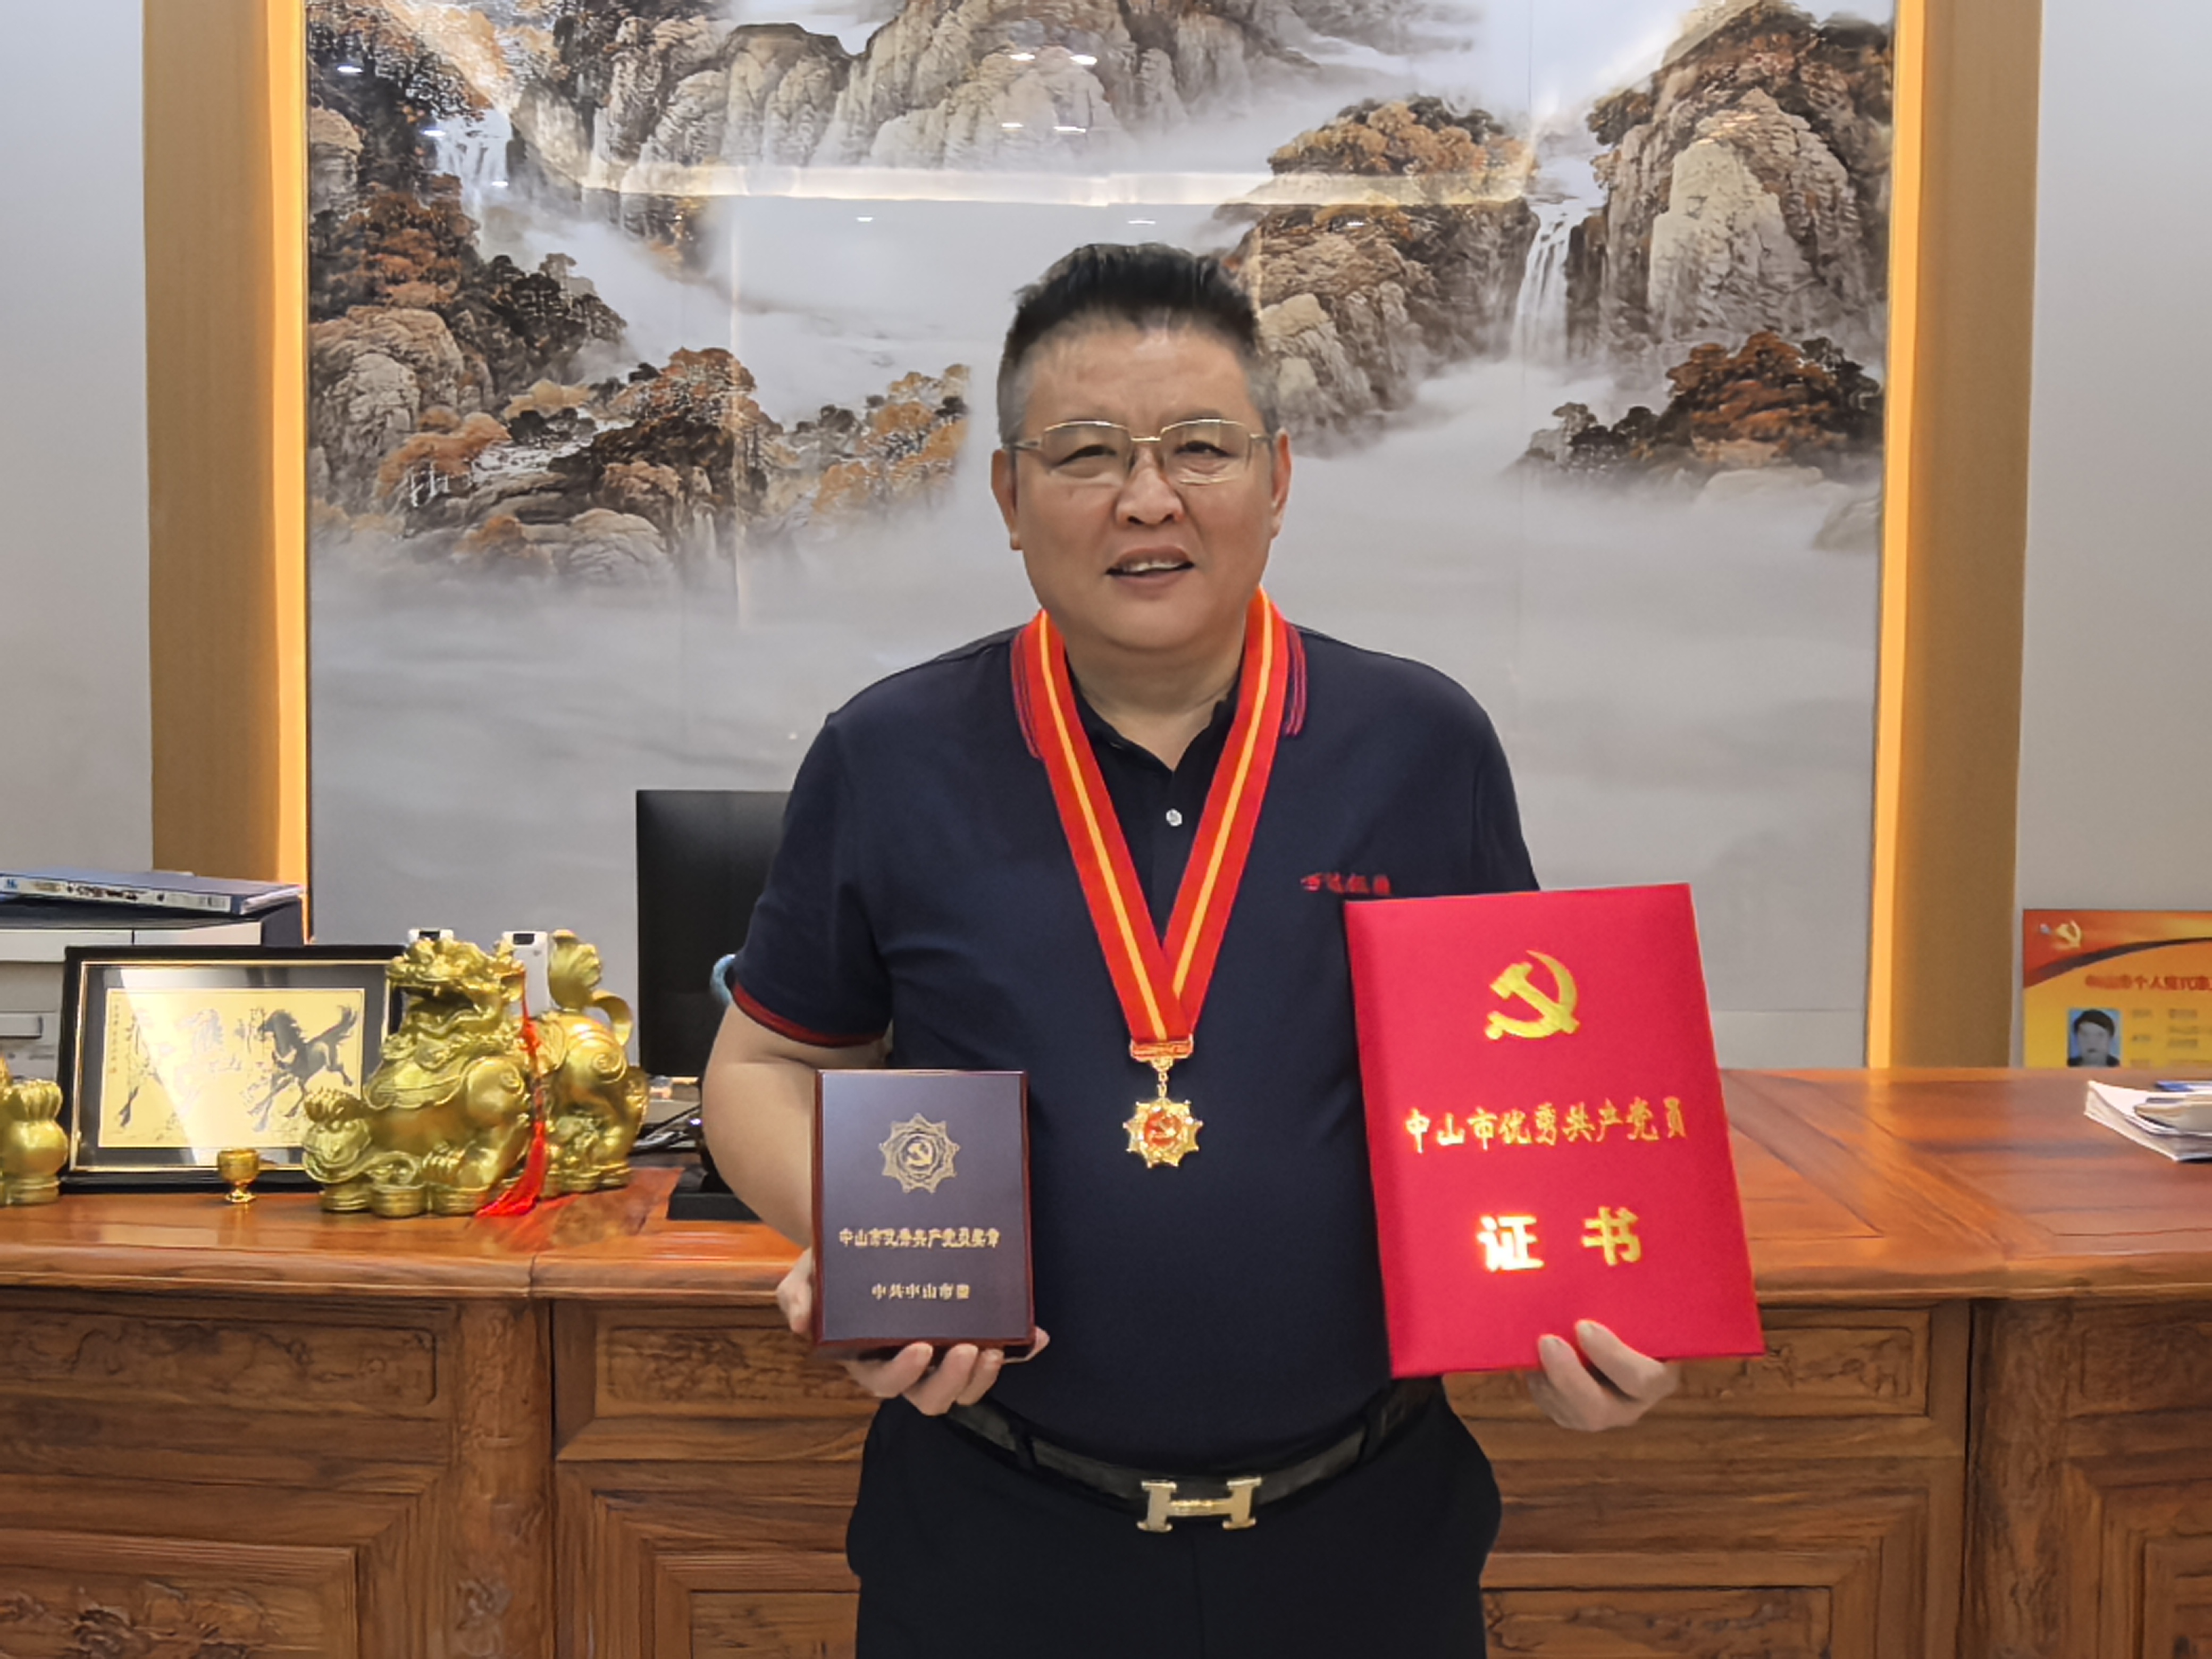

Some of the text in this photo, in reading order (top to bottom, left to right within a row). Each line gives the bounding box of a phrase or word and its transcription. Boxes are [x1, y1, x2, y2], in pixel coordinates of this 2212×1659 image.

[1405, 1095, 1687, 1153] 中山市优秀共产党员
[1476, 1206, 1641, 1271] 证书
